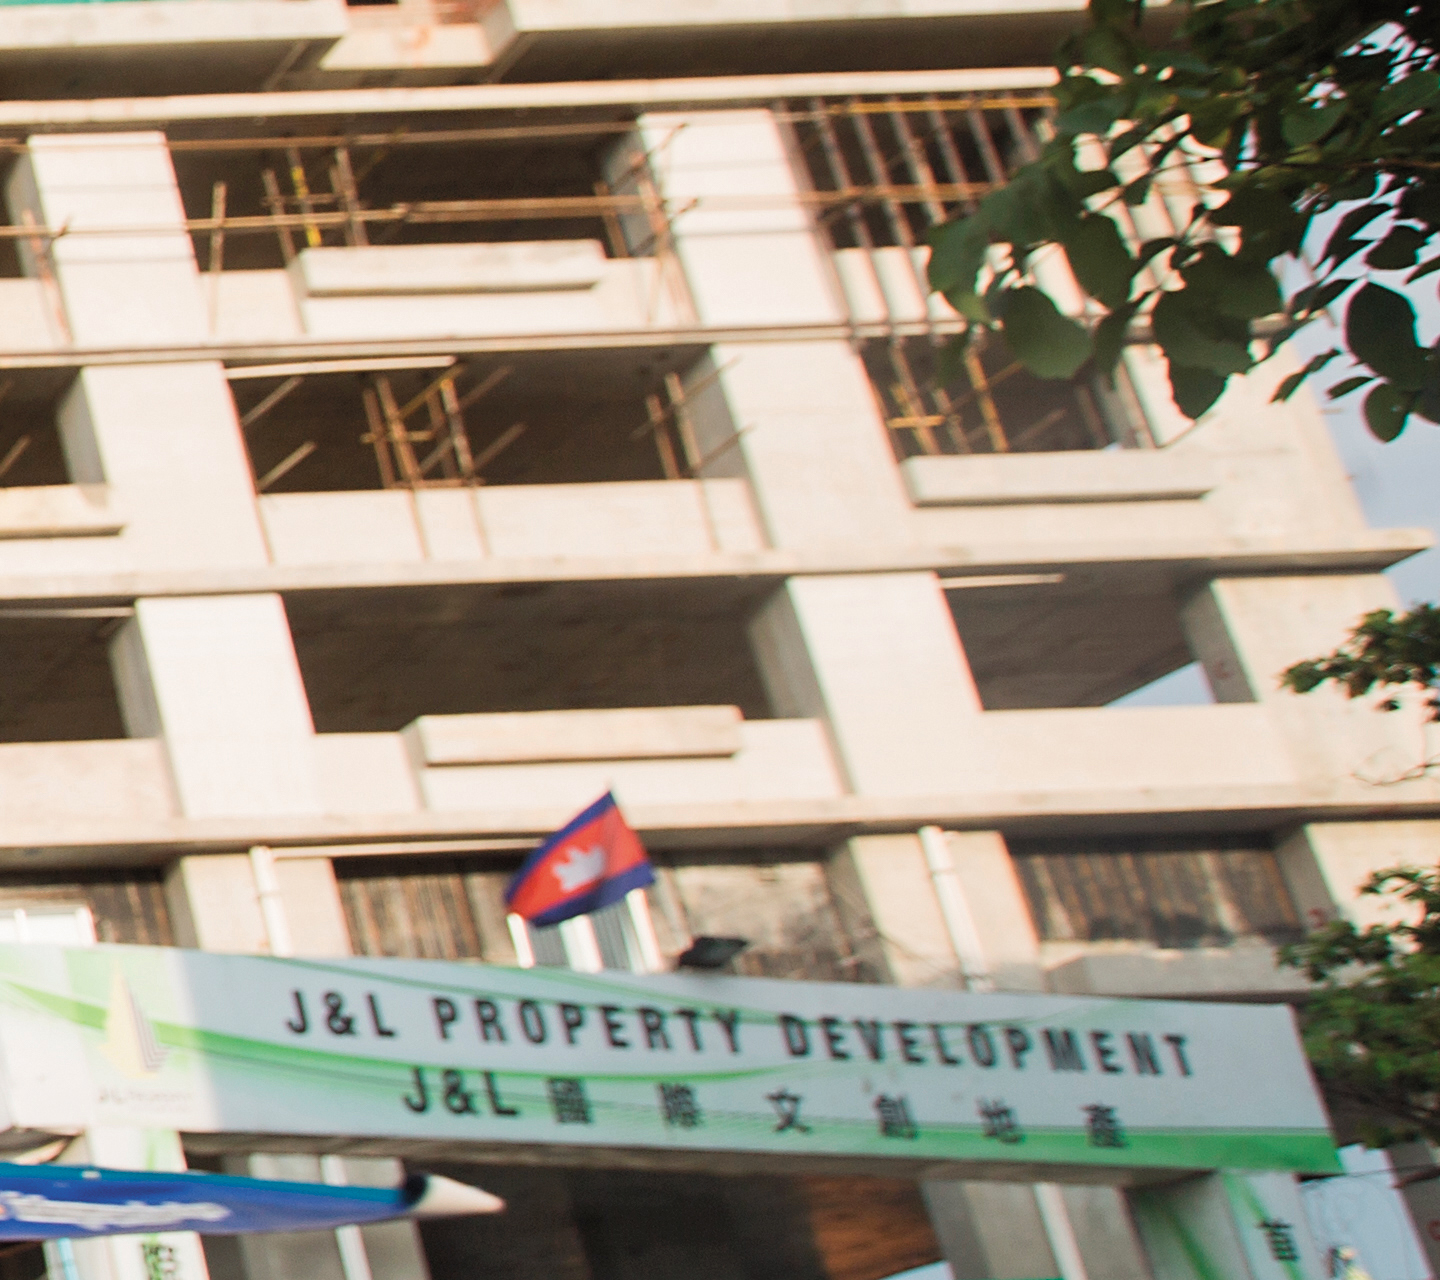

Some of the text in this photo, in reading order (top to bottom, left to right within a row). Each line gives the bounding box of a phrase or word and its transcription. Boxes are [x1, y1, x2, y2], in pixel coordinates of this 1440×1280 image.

[284, 988, 1194, 1078] J&L PROPERTY DEVELOPMENT
[401, 1064, 521, 1118] J&L
